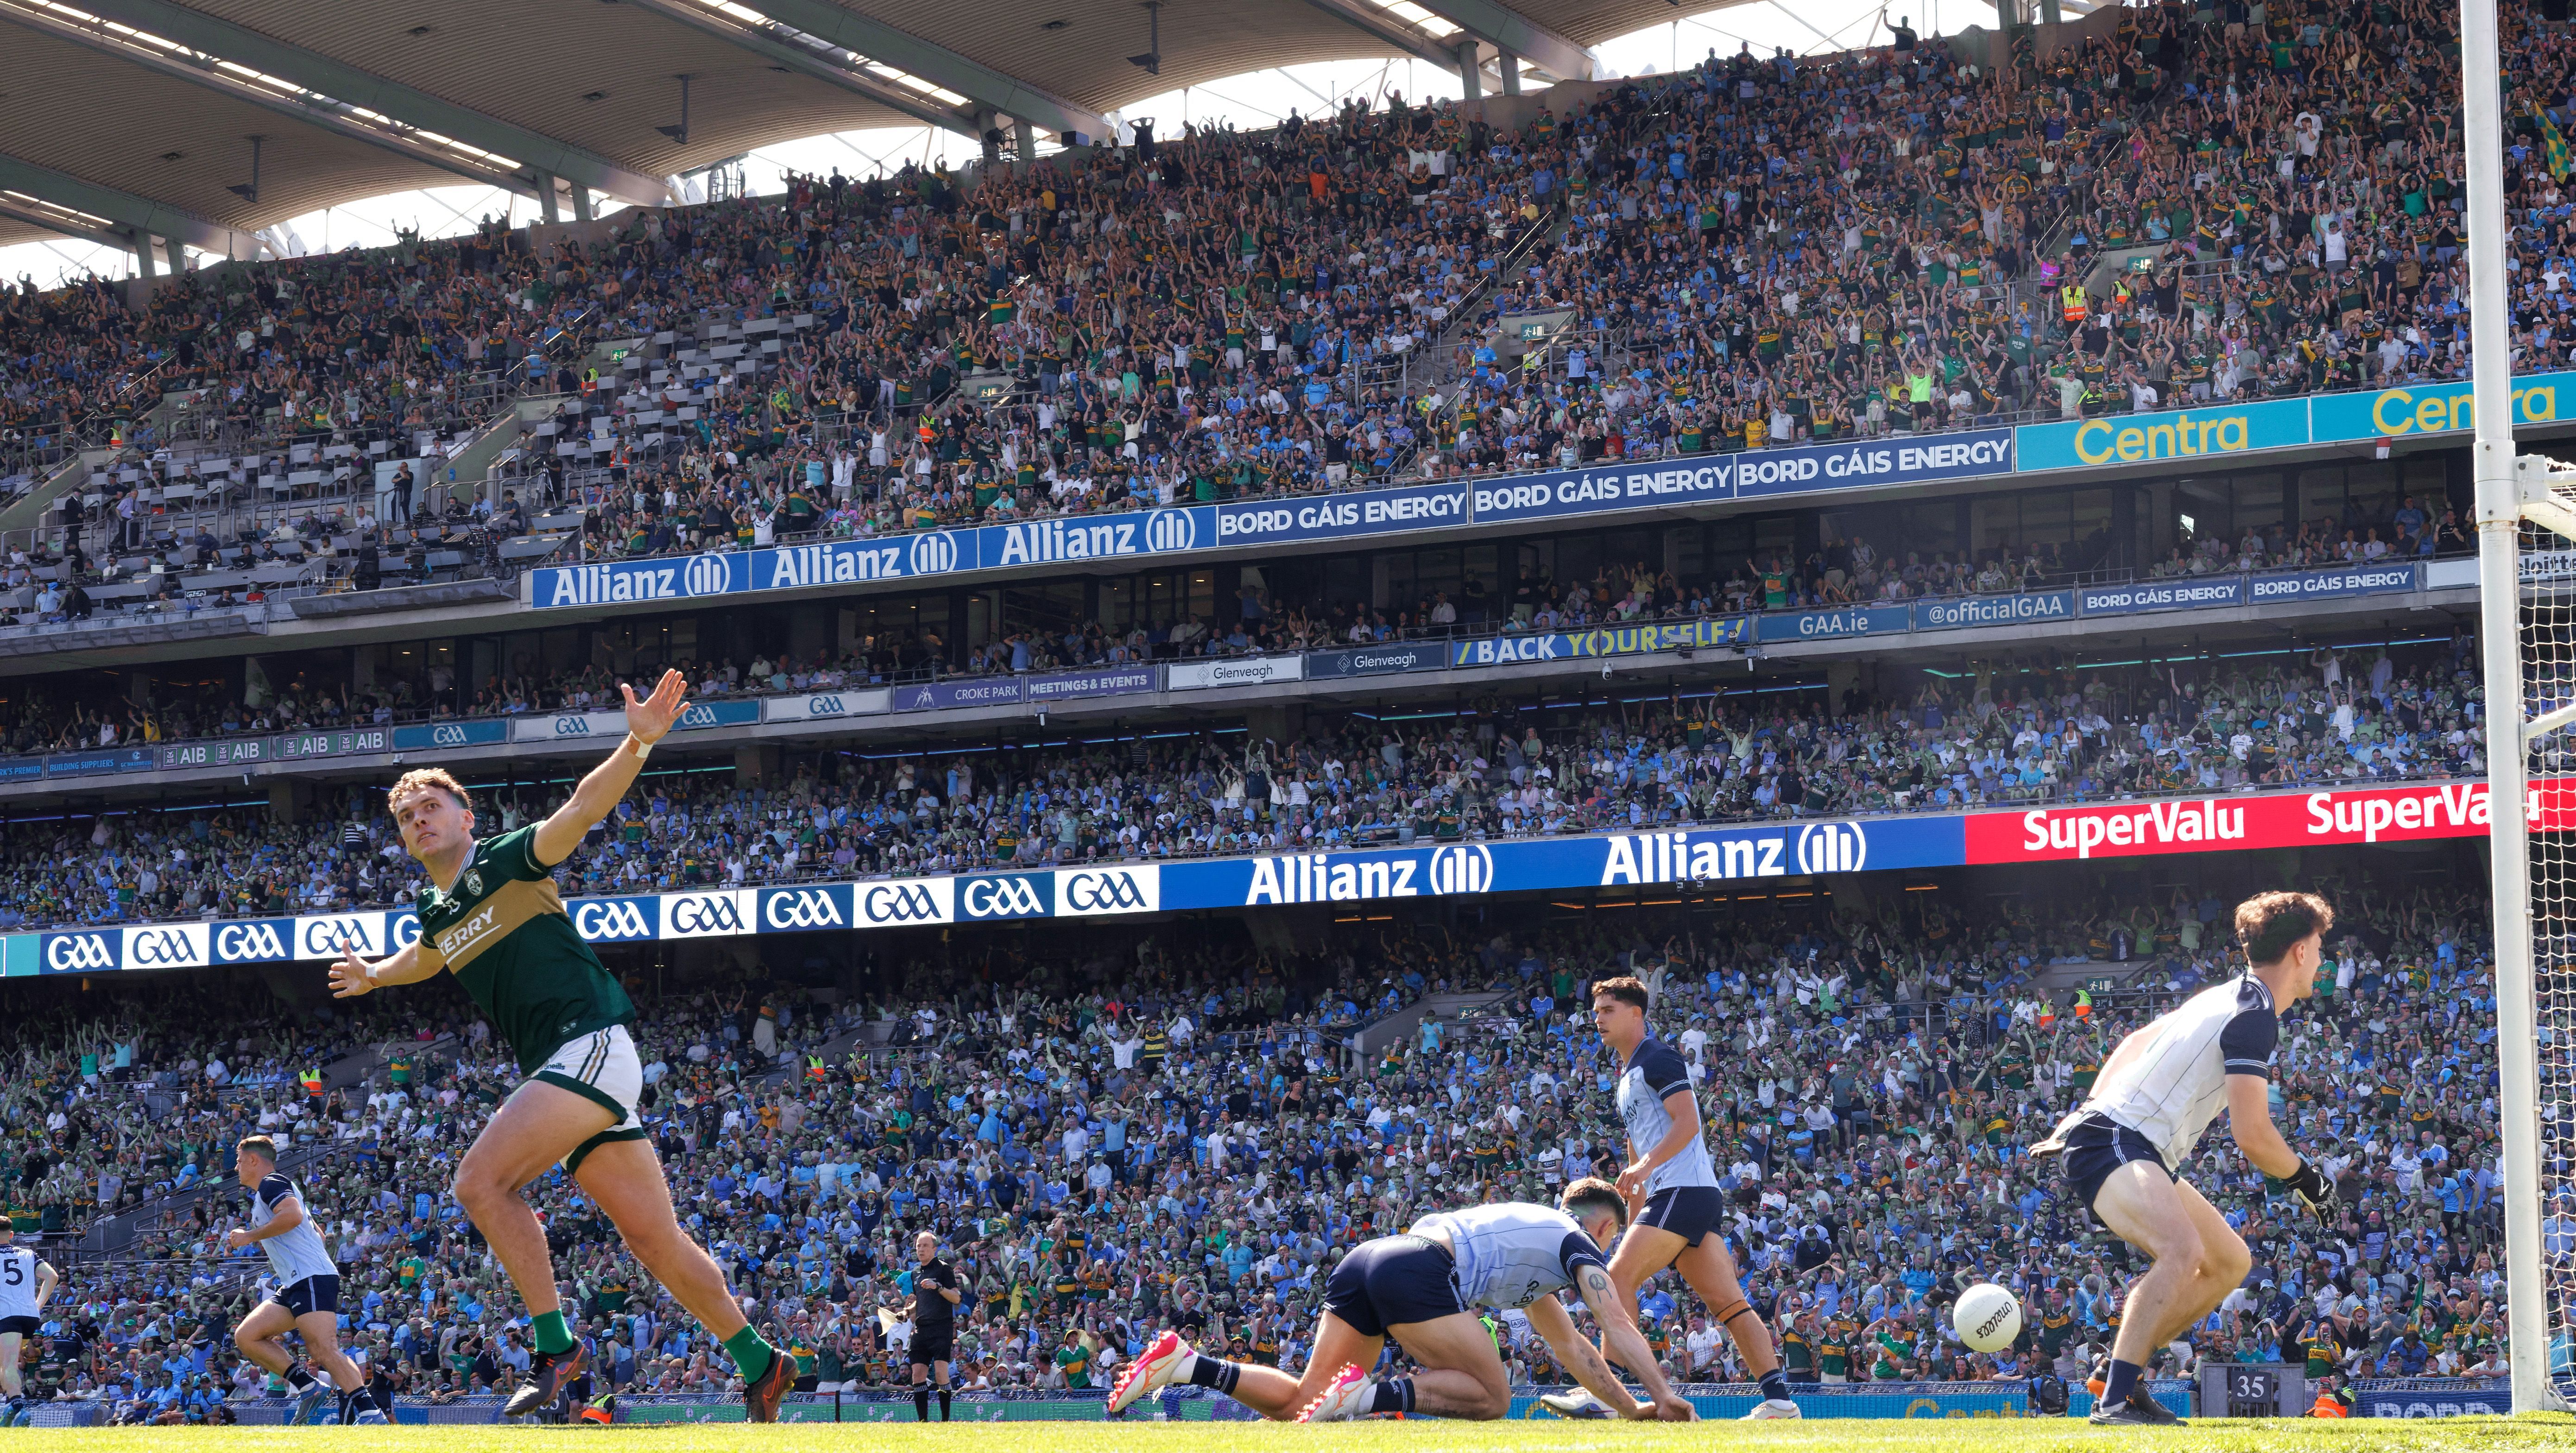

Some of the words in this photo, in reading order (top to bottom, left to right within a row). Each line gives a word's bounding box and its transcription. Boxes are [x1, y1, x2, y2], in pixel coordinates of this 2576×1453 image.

[2373, 386, 2555, 435] Cena
[2075, 415, 2248, 465] Centra
[1738, 457, 1818, 486] BORD
[1825, 448, 1892, 477] GÁIS
[1899, 439, 2010, 471] ENERGY
[1474, 484, 1551, 512] BORD
[1557, 474, 1621, 502] GÁIS
[1627, 465, 1733, 497] ENERGY
[1220, 510, 1293, 536] BORD
[1298, 500, 1358, 528] GÁIS
[1365, 493, 1466, 523] ENERGY
[1000, 520, 1136, 565] Allianz
[771, 544, 901, 588] Allianz
[2254, 580, 2301, 596] BORD
[2304, 575, 2342, 591] GÁIS
[2345, 571, 2409, 588] ENERGY
[552, 565, 676, 606] Allianz
[2087, 593, 2131, 609] BORD
[2135, 588, 2172, 605] GÁIS
[2175, 585, 2237, 602] ENERGY
[1800, 612, 1868, 634] GAA.ie
[1929, 596, 2064, 624] @officialGAA
[1213, 663, 1273, 679] Glenveagh
[1354, 651, 1416, 668] Glenveagh
[955, 688, 989, 700] CROKE
[992, 685, 1018, 698] PARK
[1030, 679, 1088, 695] MEETINGS
[1089, 678, 1098, 689] &
[1100, 675, 1147, 689] EVENTS
[682, 706, 717, 725] GAA
[809, 696, 844, 715] GAA
[356, 732, 384, 750] AIB
[433, 726, 467, 744] GAA
[556, 717, 589, 734] GAA
[180, 747, 206, 764] AIB
[232, 742, 259, 759] AIB
[301, 737, 328, 754] AIB
[15, 766, 41, 774] PREMIER
[50, 762, 79, 771] BUILDING
[81, 759, 114, 769] SUPPLIERS
[2023, 799, 2245, 859] SuperValu
[2307, 784, 2539, 842] SuperVa
[1600, 832, 1785, 885] Allianz
[964, 878, 1044, 917] GAA
[1066, 872, 1147, 911] GAA
[1245, 853, 1417, 906] Allianz
[575, 901, 650, 940] GAA
[670, 896, 745, 932] GAA
[766, 890, 843, 929] GAA
[865, 884, 942, 922] GAA
[48, 934, 114, 970] GAA
[133, 929, 198, 965] GAA
[217, 924, 286, 960] GAA
[305, 919, 373, 955] GAA
[4, 1258, 23, 1286] 5
[2236, 1375, 2265, 1398] 35
